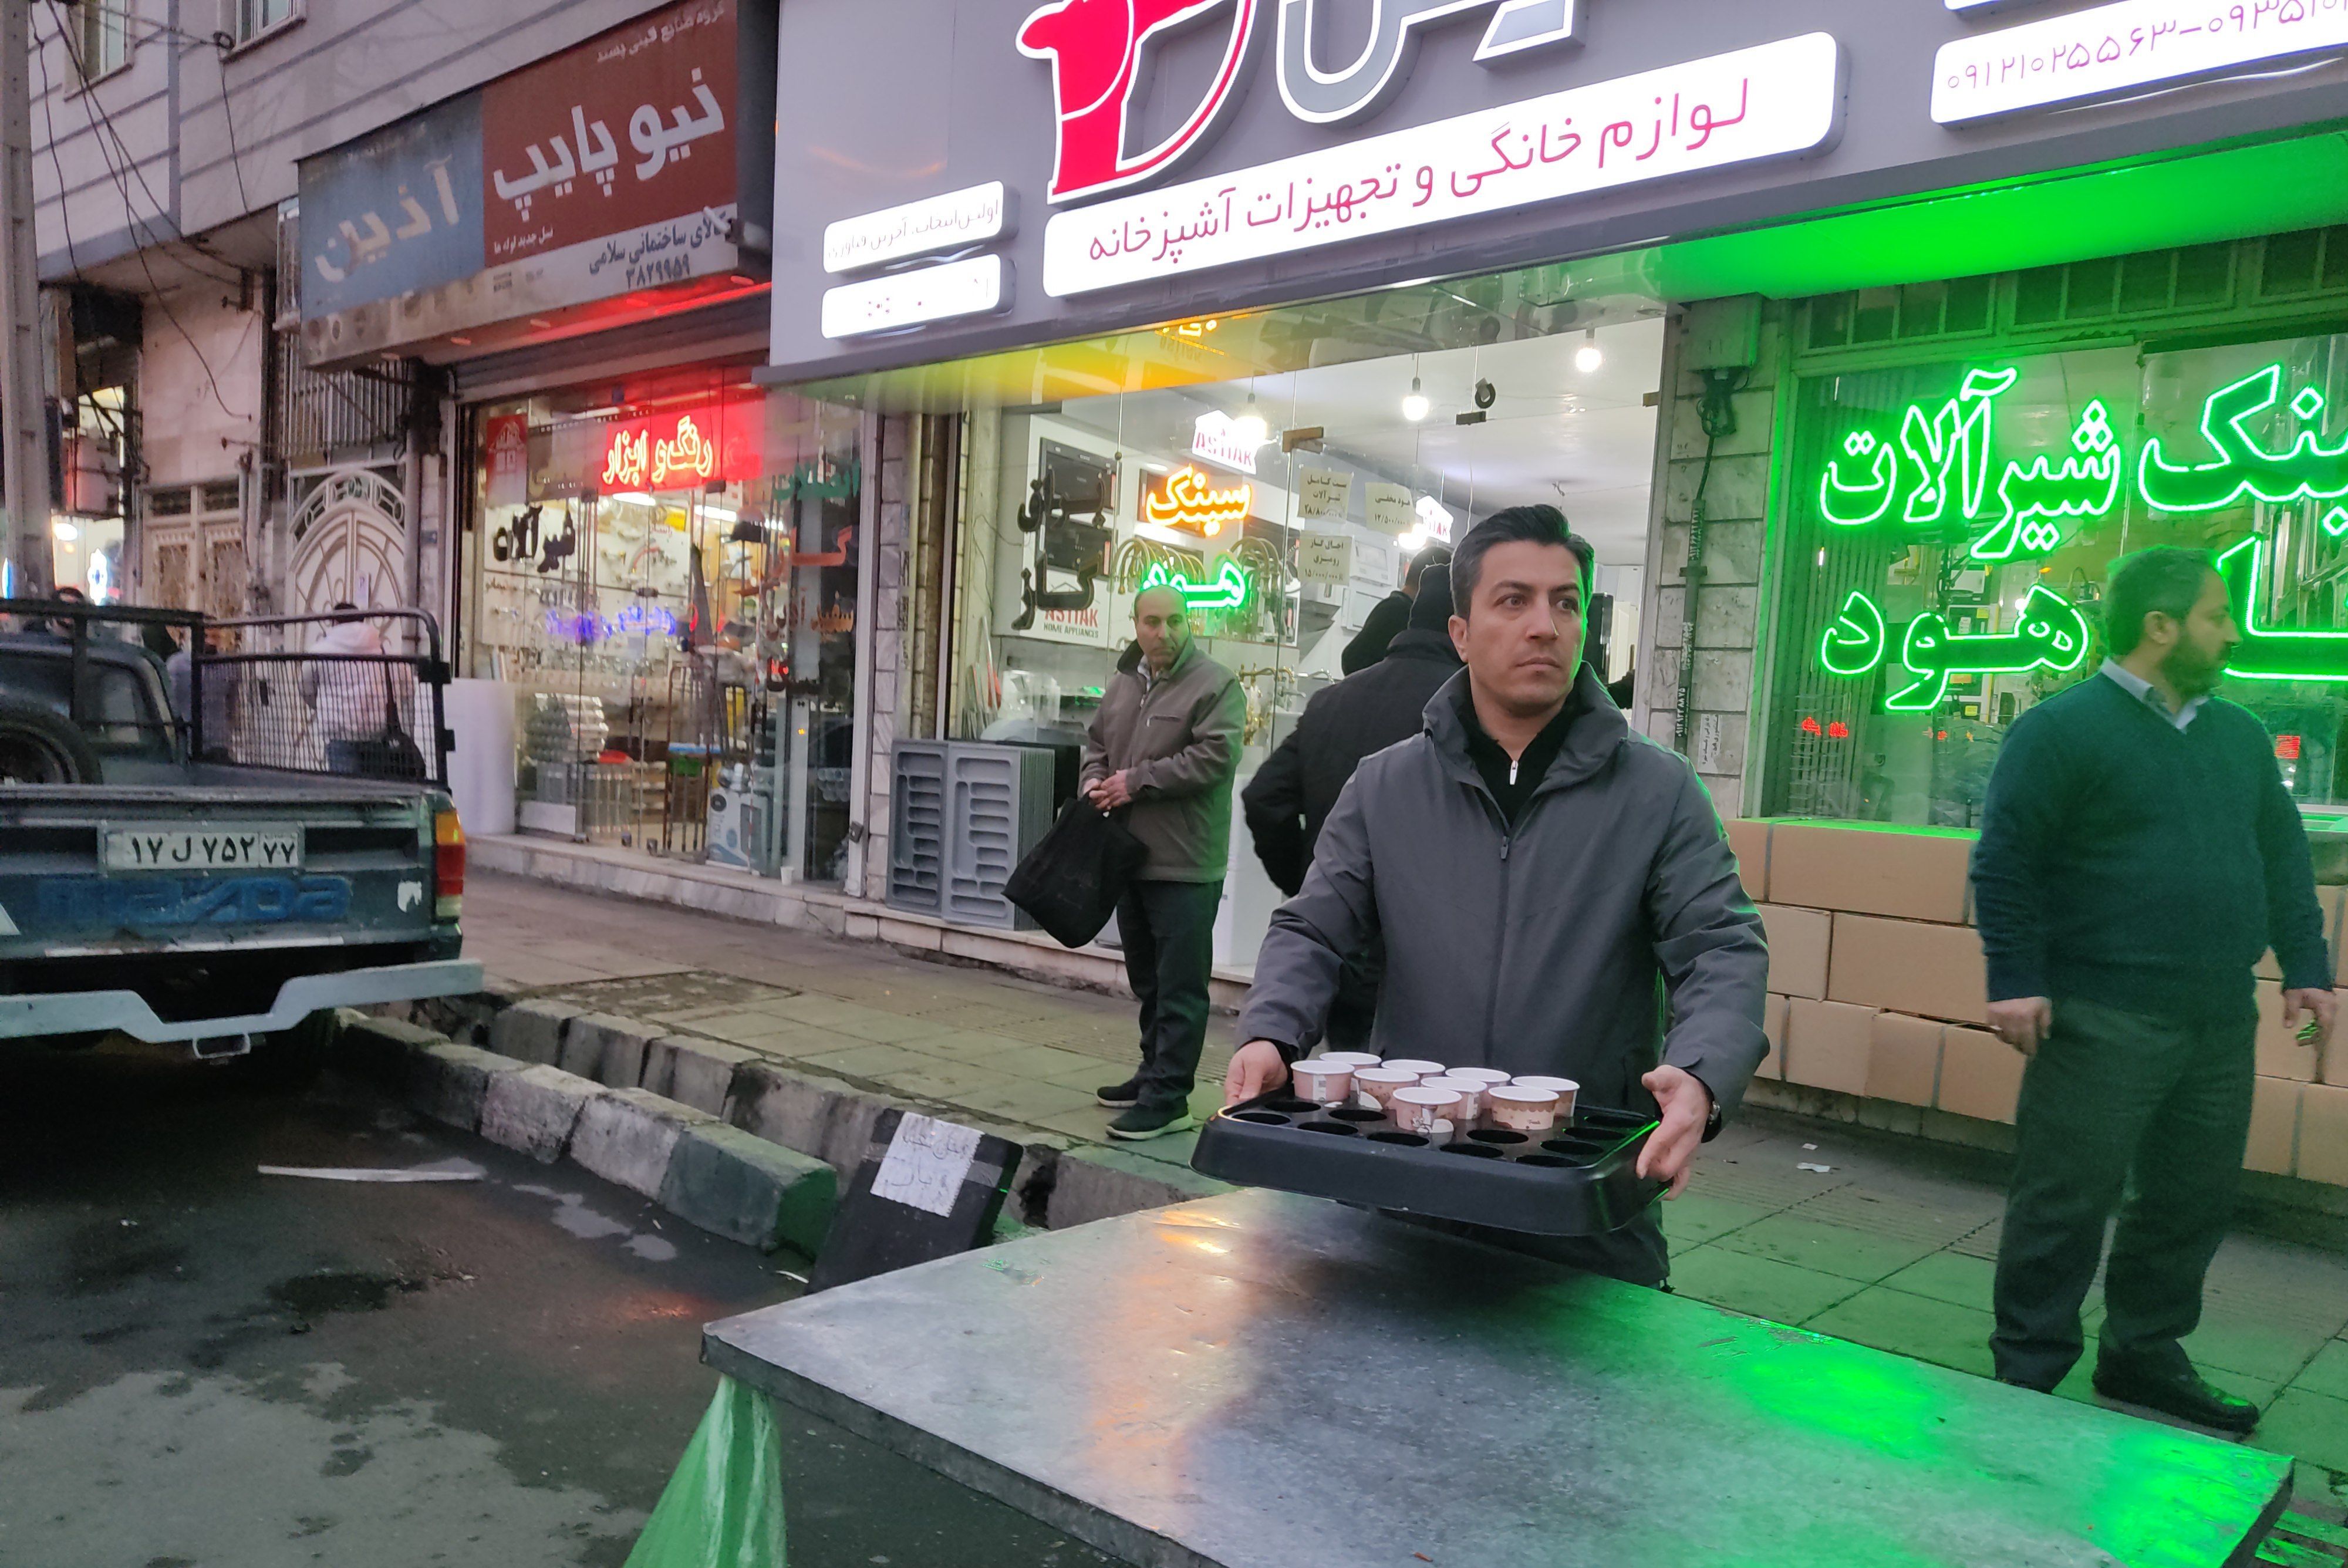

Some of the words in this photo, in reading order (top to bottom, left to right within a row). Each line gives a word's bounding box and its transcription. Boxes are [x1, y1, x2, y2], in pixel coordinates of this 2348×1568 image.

[1450, 117, 1582, 198] خانگی
[1598, 78, 1748, 168] لوازم
[494, 105, 619, 222] پایپ
[1246, 163, 1401, 233] تجهیزات
[1412, 166, 1433, 207] و
[589, 240, 626, 276] سلامی
[629, 224, 686, 264] ساختمانی
[1089, 187, 1236, 264] آشپزخانه
[1145, 463, 1253, 537] سینک
[1044, 622, 1062, 633] HOME
[1064, 625, 1099, 639] APPLIANCES
[1820, 583, 2091, 711] هود
[171, 836, 191, 863] ل
[202, 836, 255, 864] ۷۵۲
[264, 841, 295, 864] ۷۷
